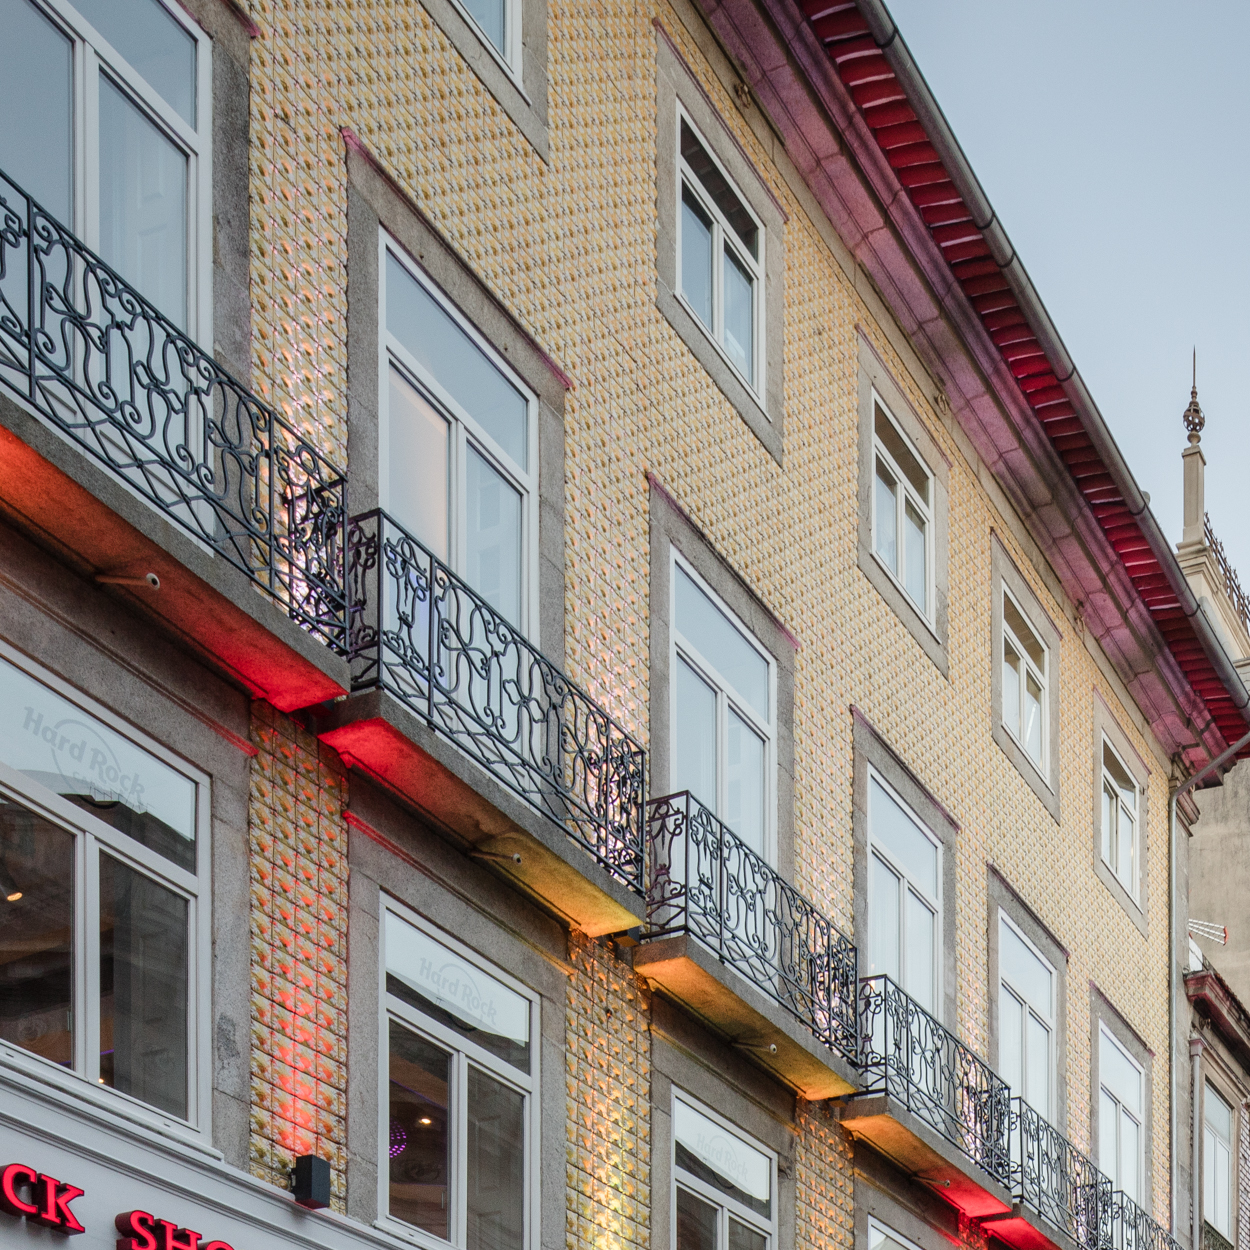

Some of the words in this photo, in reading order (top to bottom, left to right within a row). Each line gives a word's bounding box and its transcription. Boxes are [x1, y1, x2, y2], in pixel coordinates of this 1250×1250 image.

[22, 705, 88, 763] Hard
[89, 747, 146, 808] Rock
[419, 957, 460, 997] Hard
[460, 983, 497, 1026] Rock
[694, 1132, 724, 1162] Hard
[724, 1149, 749, 1182] Rock
